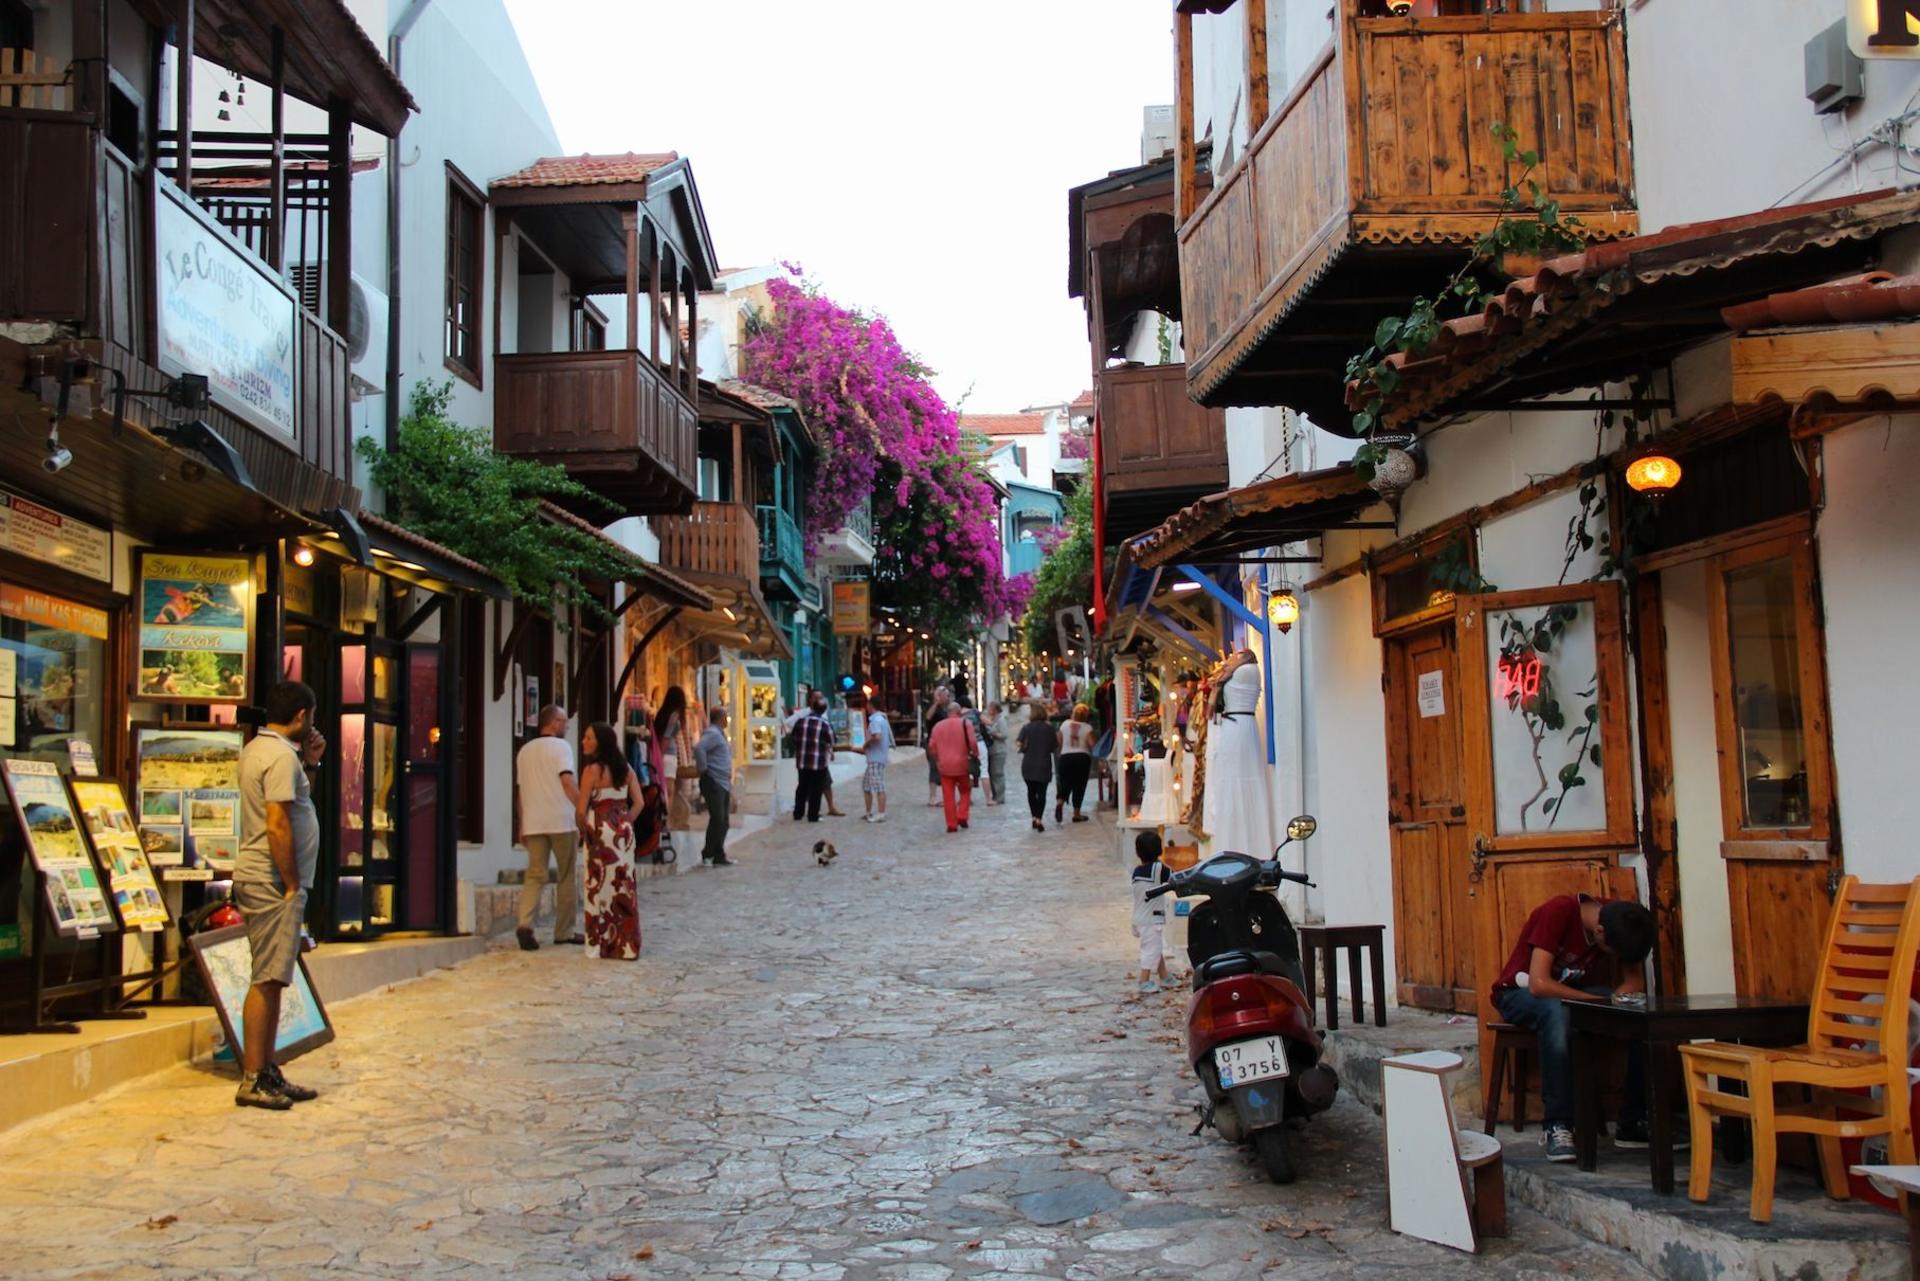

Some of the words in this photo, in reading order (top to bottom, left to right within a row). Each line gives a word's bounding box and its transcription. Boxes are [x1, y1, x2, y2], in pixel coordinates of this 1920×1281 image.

[166, 250, 192, 288] Le
[195, 241, 244, 304] Congé
[247, 277, 289, 363] Travel
[166, 287, 240, 354] Adventure
[255, 347, 290, 399] Diving
[185, 560, 241, 585] Kayak
[163, 631, 223, 648] Kekova
[1222, 1047, 1240, 1063] 07
[1267, 1040, 1275, 1053] Y
[1238, 1059, 1280, 1079] 3756
